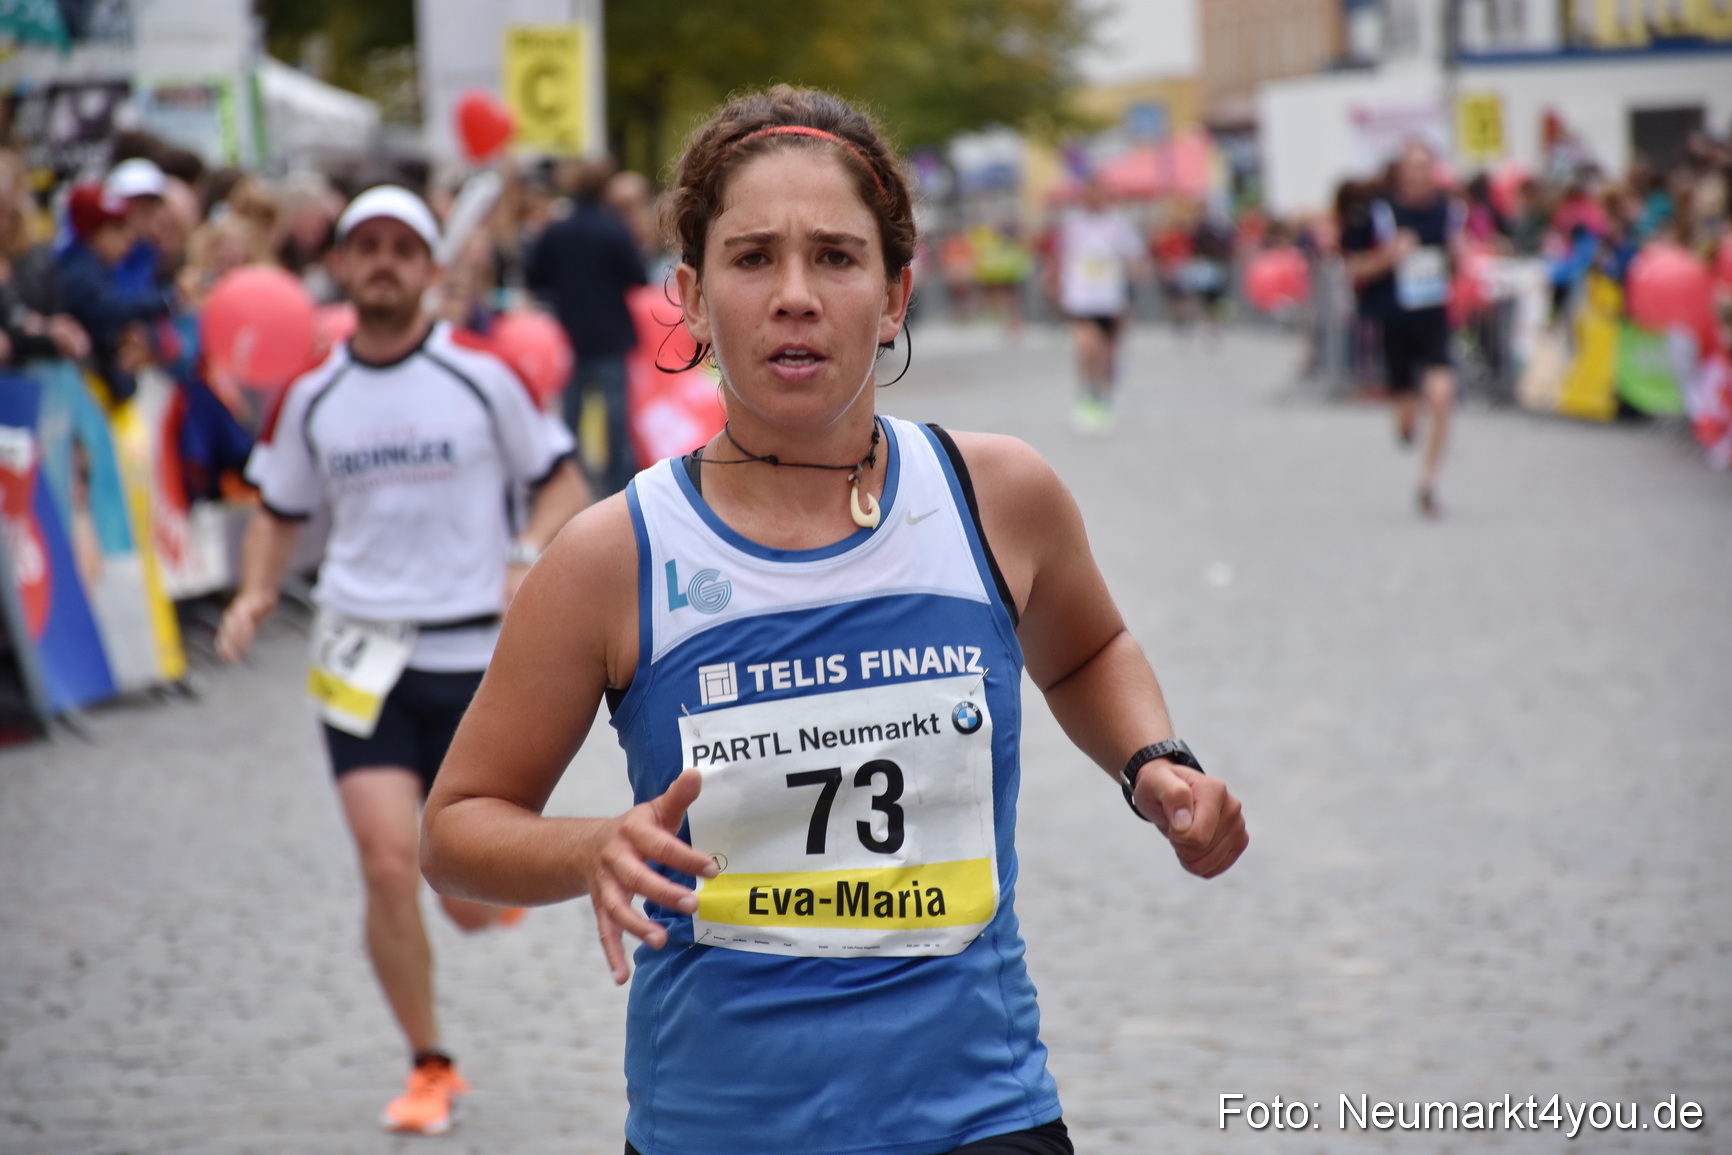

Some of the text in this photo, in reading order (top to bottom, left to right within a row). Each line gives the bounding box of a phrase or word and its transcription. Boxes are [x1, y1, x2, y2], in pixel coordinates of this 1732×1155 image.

[665, 559, 732, 615] LG
[747, 645, 984, 692] TELIS FINANZ
[691, 712, 941, 767] PARTL Neumarkt
[785, 759, 905, 855] 73
[748, 880, 946, 918] Eva-Maria
